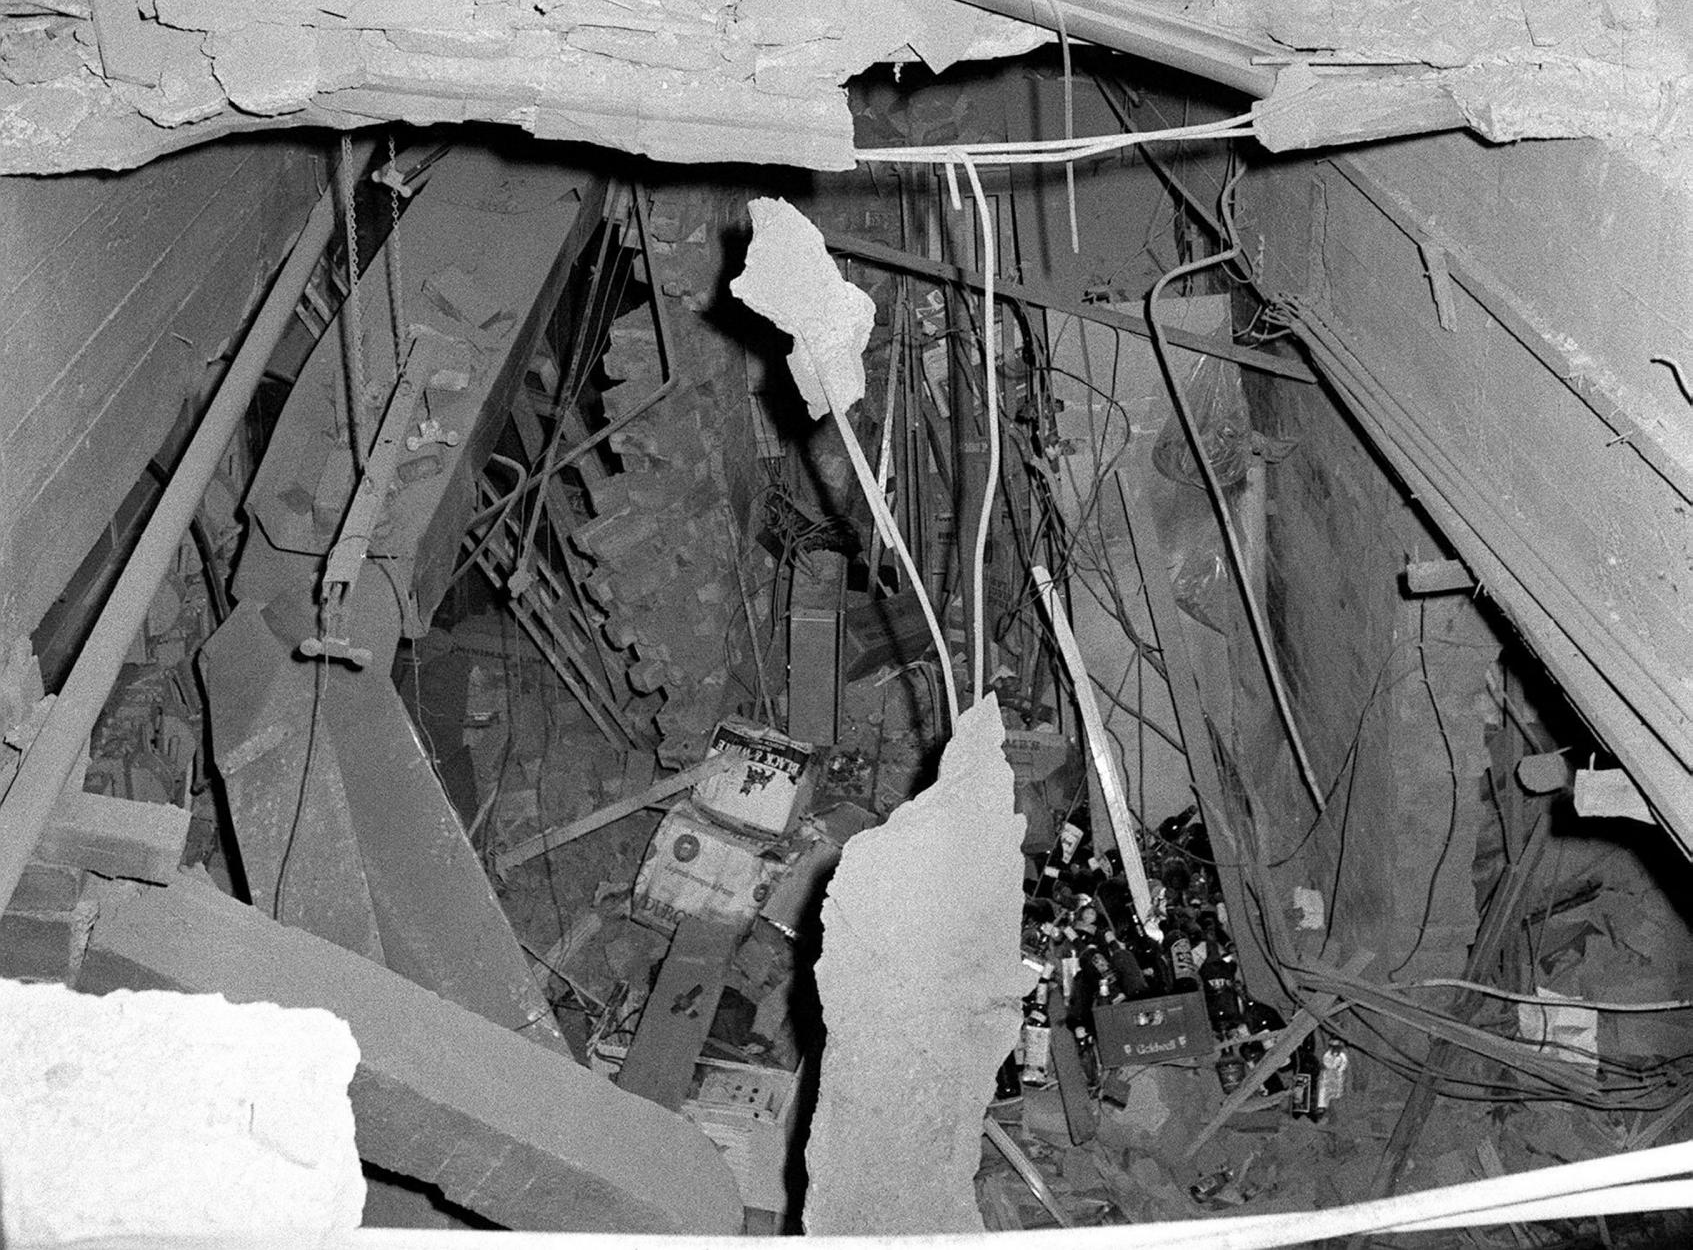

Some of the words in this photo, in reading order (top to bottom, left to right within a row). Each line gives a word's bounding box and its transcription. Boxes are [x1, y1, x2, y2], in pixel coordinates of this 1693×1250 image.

[754, 749, 764, 762] &
[763, 752, 801, 776] BLACK
[643, 895, 700, 924] DUBO
